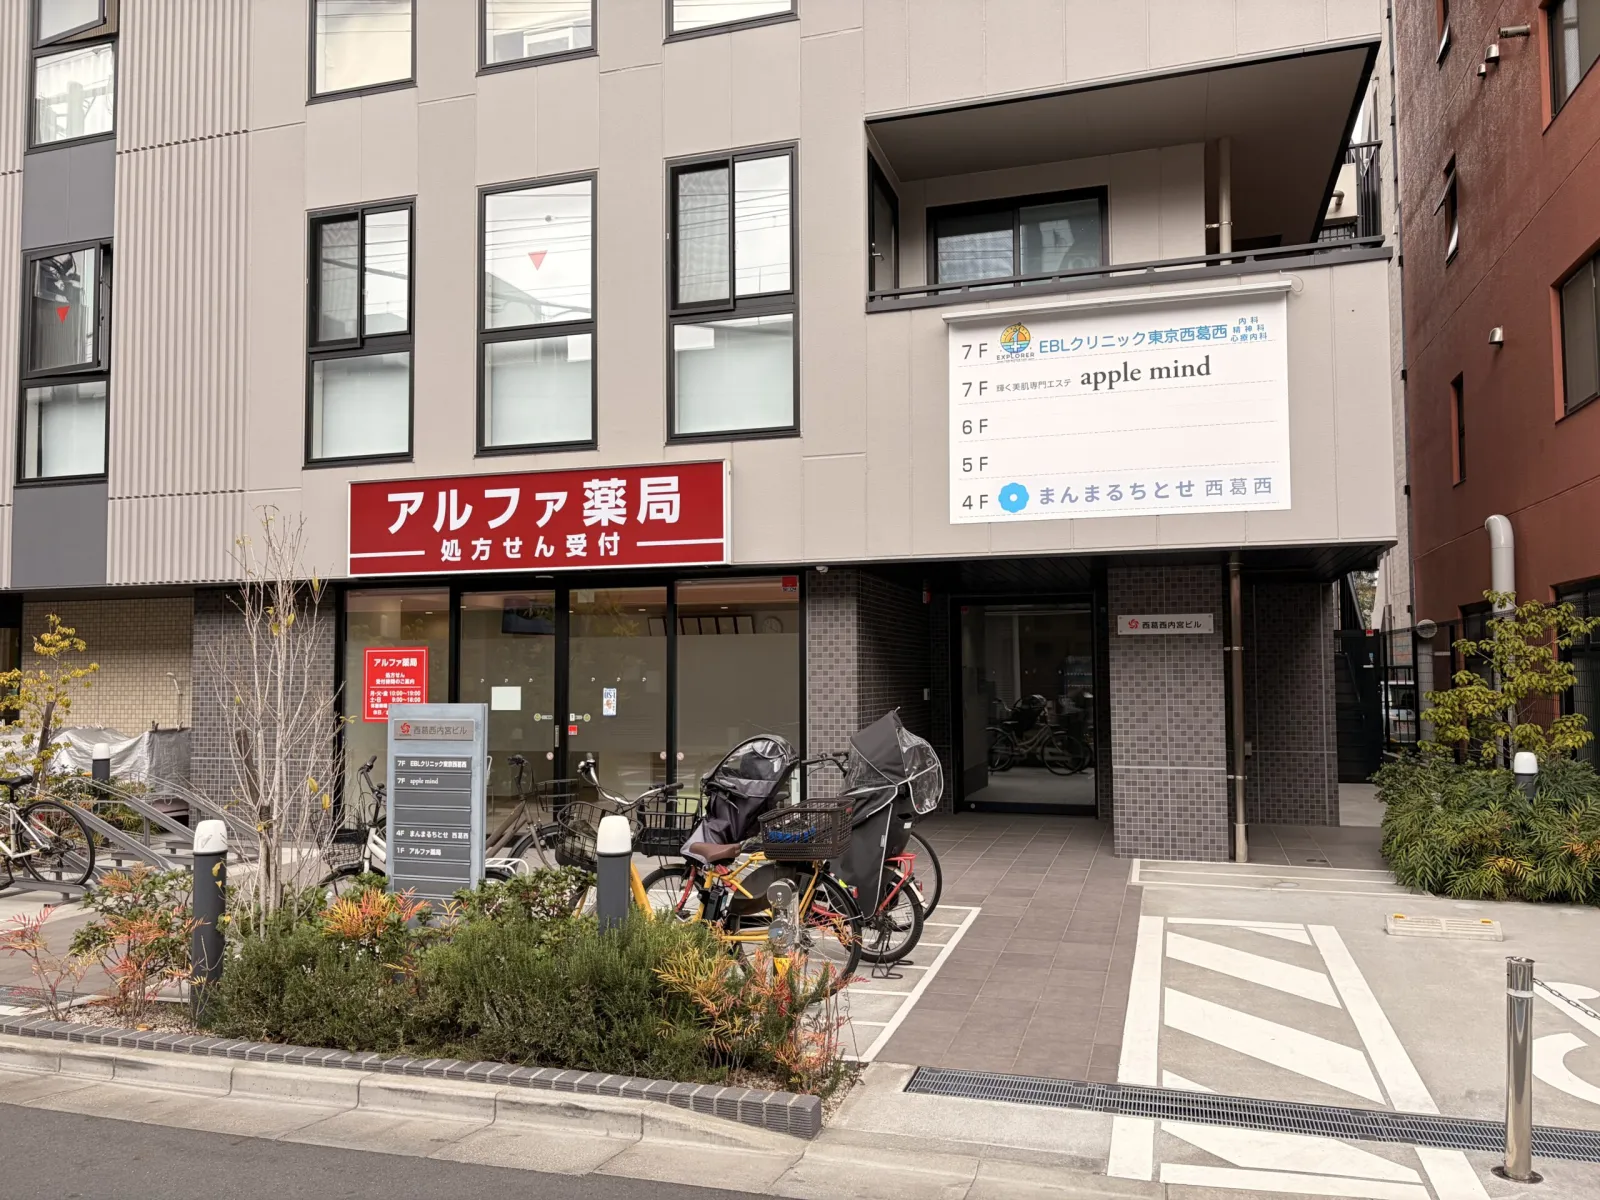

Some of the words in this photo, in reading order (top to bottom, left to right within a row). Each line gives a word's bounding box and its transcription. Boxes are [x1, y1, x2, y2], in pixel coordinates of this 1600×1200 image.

[1238, 315, 1259, 325] 内科
[1039, 324, 1228, 354] EBLクリニック東京西葛西
[996, 352, 1035, 361] EXPLORER
[996, 378, 1072, 393] 輝く美肌専門エステ
[1080, 361, 1142, 391] apple
[1149, 355, 1212, 380] mind
[1039, 479, 1196, 506] まんまるちとせ
[1204, 476, 1273, 498] 西葛西
[387, 475, 681, 535] アルファ薬局
[440, 532, 621, 562] 処方せん受付
[1142, 620, 1202, 630] 西葛西内宮ビル
[373, 657, 418, 667] アルファ薬局
[413, 725, 468, 735] 西葛西内宮ビル
[409, 777, 424, 786] apple
[424, 777, 439, 785] mind
[396, 829, 405, 837] 4F
[409, 830, 449, 839] まんまるちとせ
[409, 847, 442, 856] アルファ薬局
